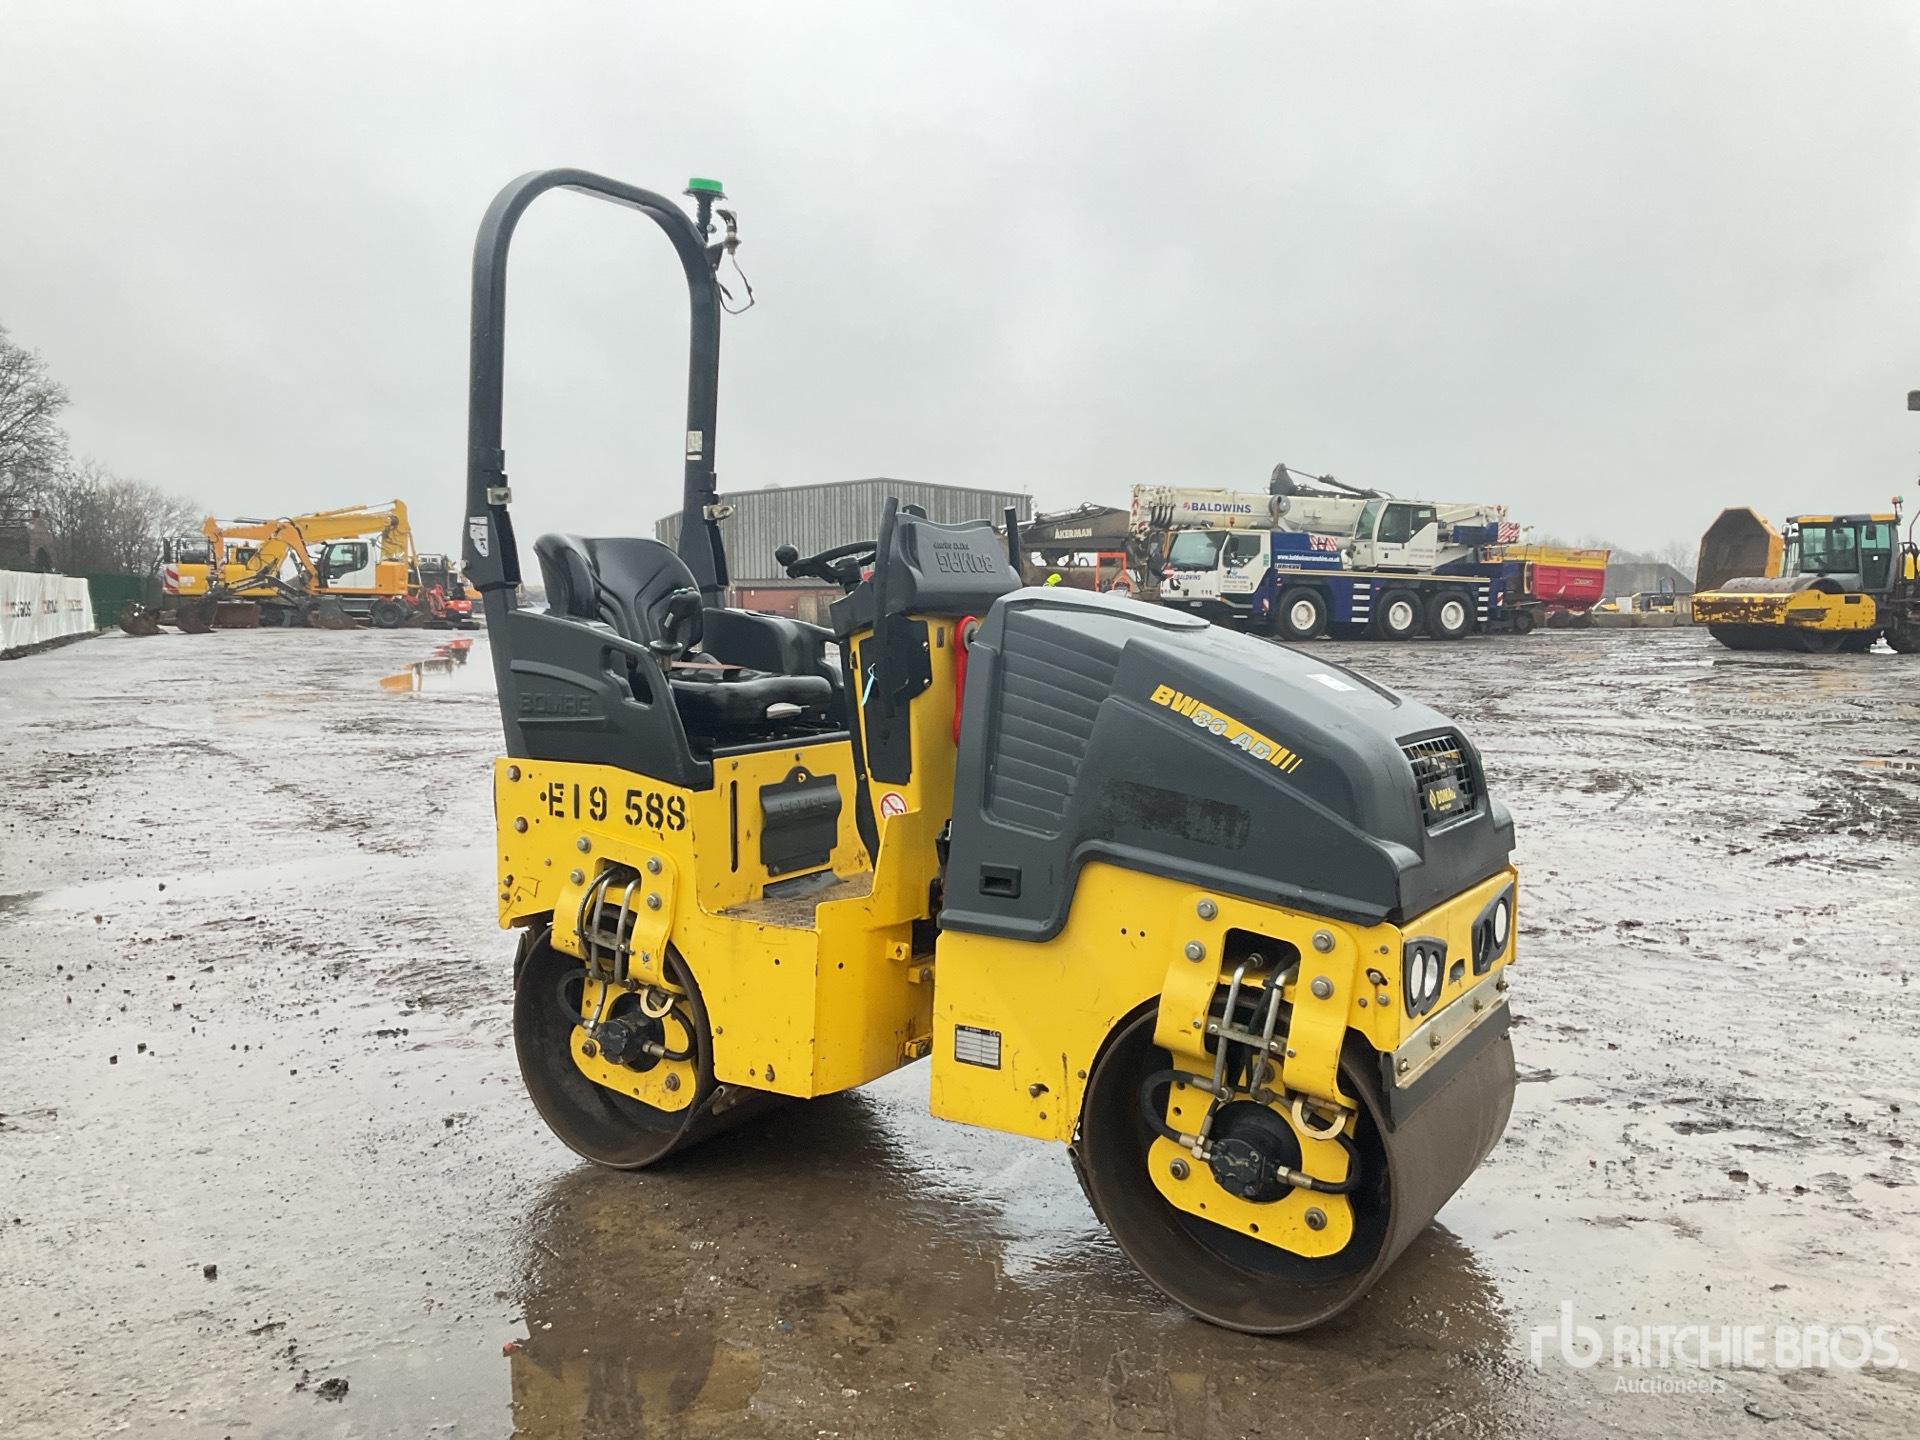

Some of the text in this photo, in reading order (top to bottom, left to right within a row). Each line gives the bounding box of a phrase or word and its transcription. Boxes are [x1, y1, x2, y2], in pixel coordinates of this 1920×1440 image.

[1191, 502, 1252, 514] BALDWINS
[519, 692, 592, 715] BOMAG
[1150, 684, 1228, 736] BW80
[549, 782, 686, 831] E19 588
